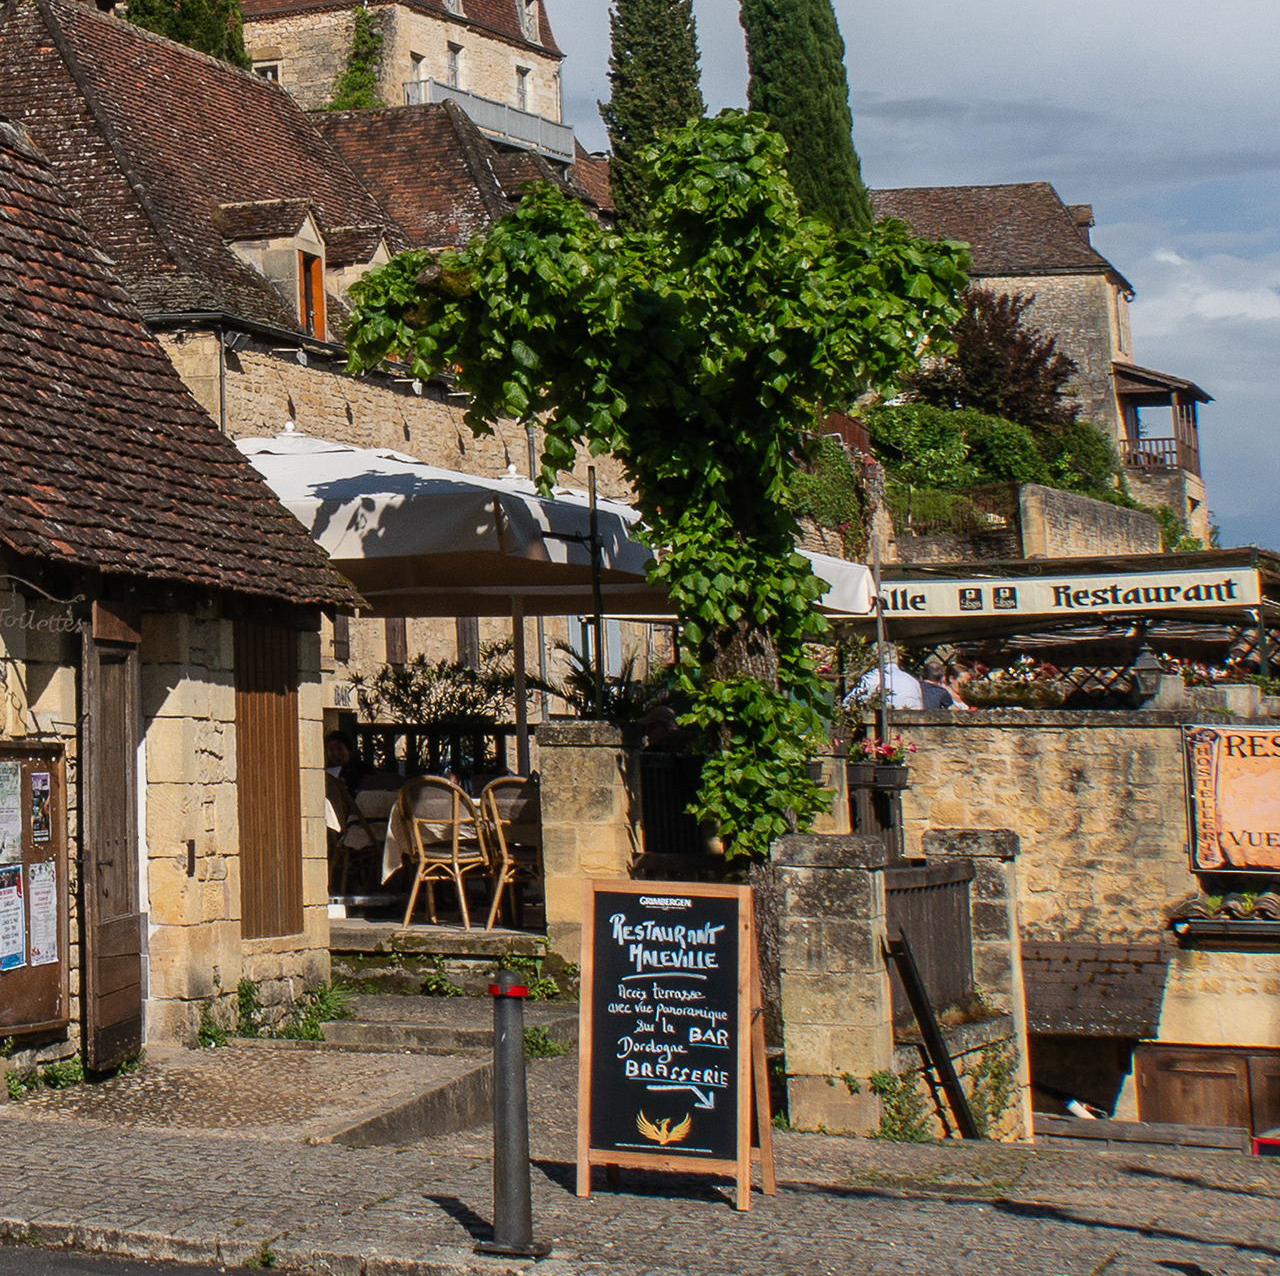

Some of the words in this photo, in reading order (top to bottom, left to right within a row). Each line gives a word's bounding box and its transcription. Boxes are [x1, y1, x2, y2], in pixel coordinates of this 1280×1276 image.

[1051, 578, 1237, 608] Restaurant
[639, 896, 692, 907] GRIMBERGEN
[652, 982, 706, 1001] terrasse
[608, 1003, 632, 1013] avec
[662, 1017, 675, 1033] la
[689, 1027, 728, 1045] BAR
[616, 1036, 688, 1063] Dordogne
